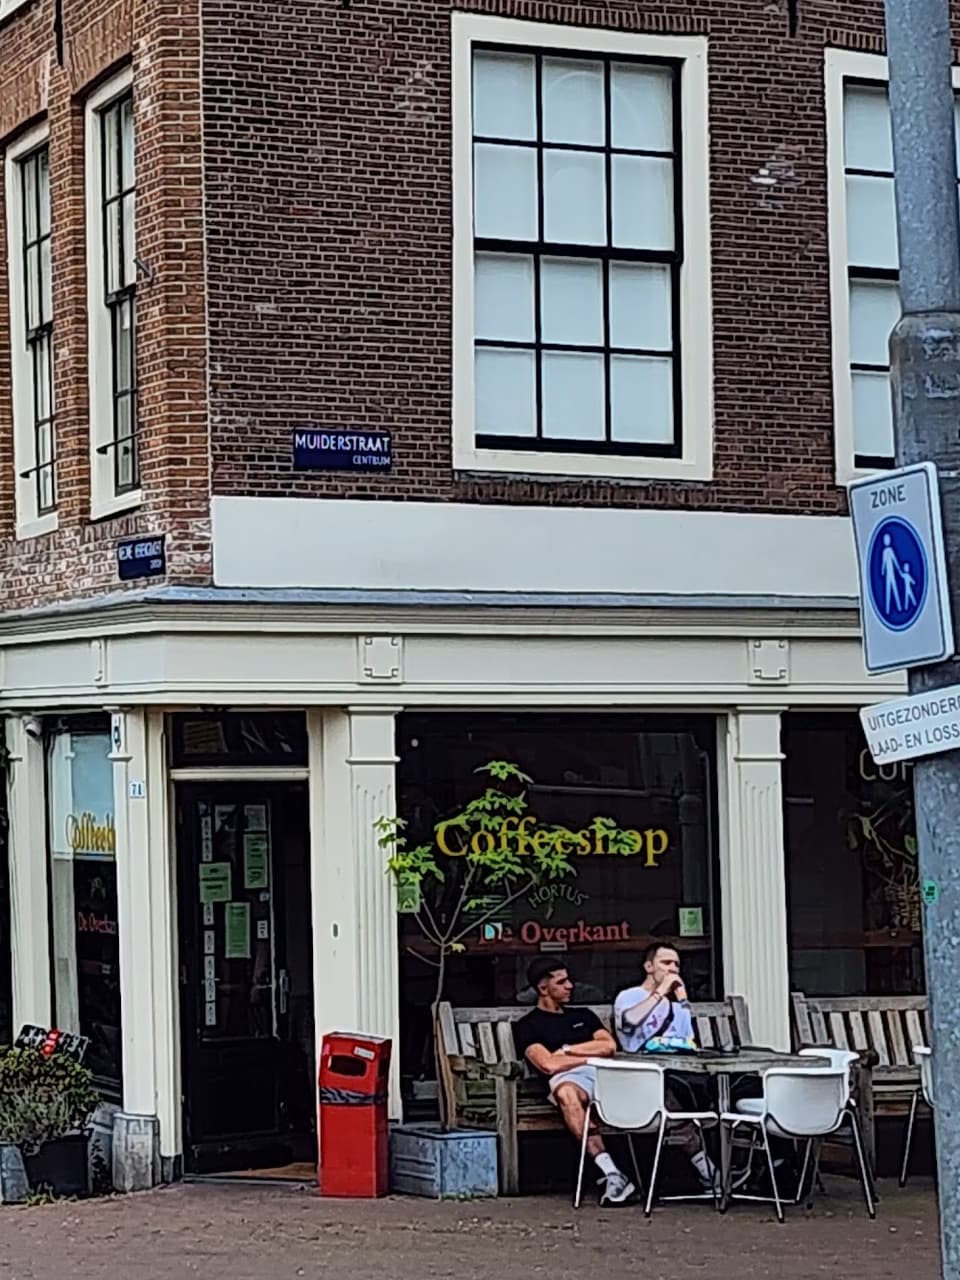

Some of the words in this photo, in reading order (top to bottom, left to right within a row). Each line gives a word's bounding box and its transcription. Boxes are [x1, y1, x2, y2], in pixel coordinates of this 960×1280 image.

[295, 433, 390, 452] MUIDERSTRAAT
[352, 454, 391, 465] CENTRUM
[870, 484, 906, 509] ZONE
[871, 737, 903, 757] LAAD-
[905, 731, 922, 749] EN
[925, 723, 960, 744] LOSS
[435, 816, 669, 867] Coffeeshop
[528, 883, 589, 908] HORTUS
[521, 920, 632, 944] Overkant
